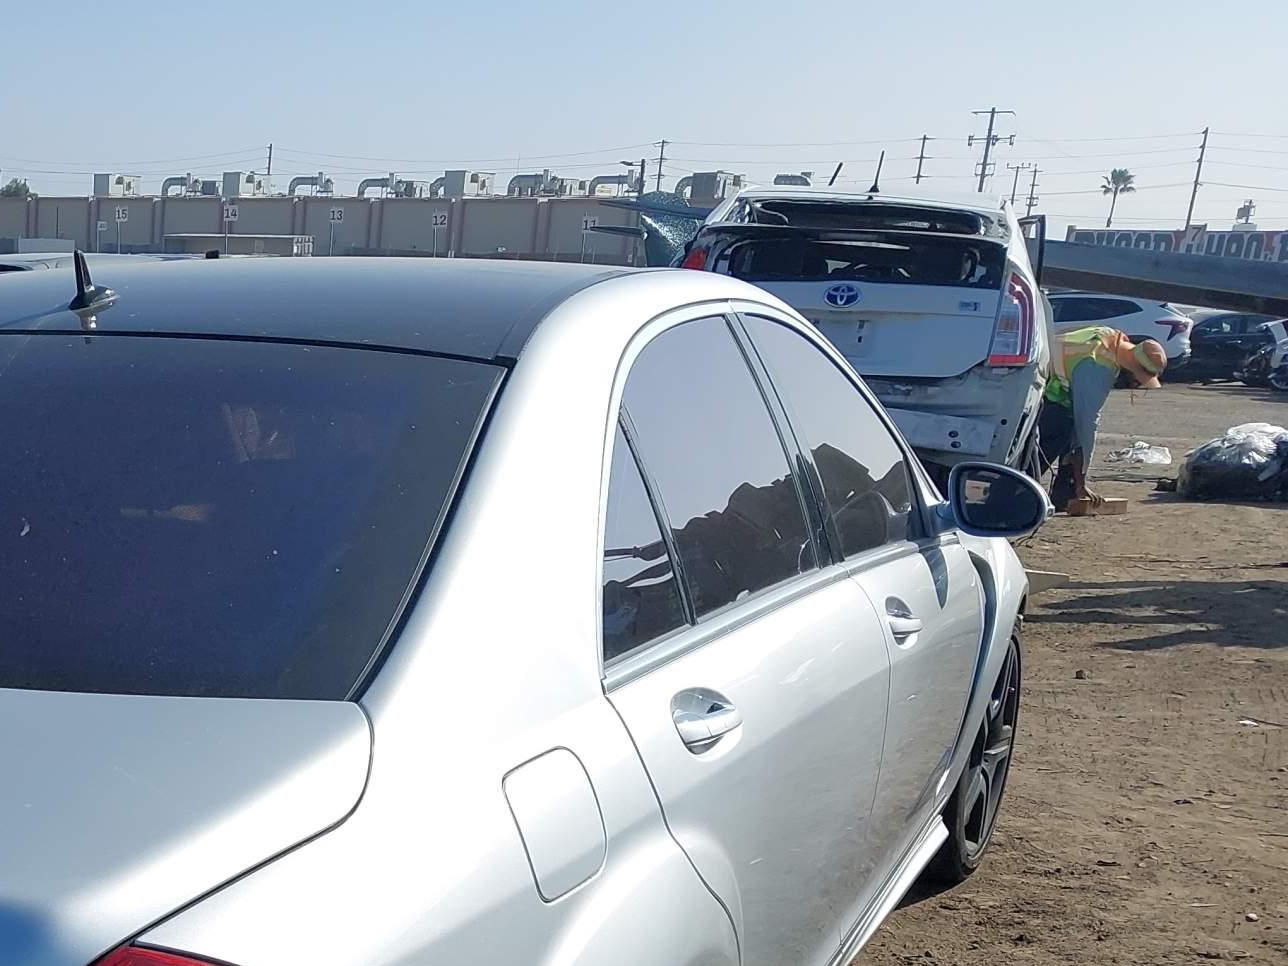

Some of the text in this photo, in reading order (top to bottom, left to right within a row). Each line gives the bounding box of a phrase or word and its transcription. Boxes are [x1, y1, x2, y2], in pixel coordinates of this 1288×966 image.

[116, 208, 128, 220] 15
[224, 208, 238, 218] 14
[330, 210, 343, 220] 13
[433, 215, 447, 226] 12
